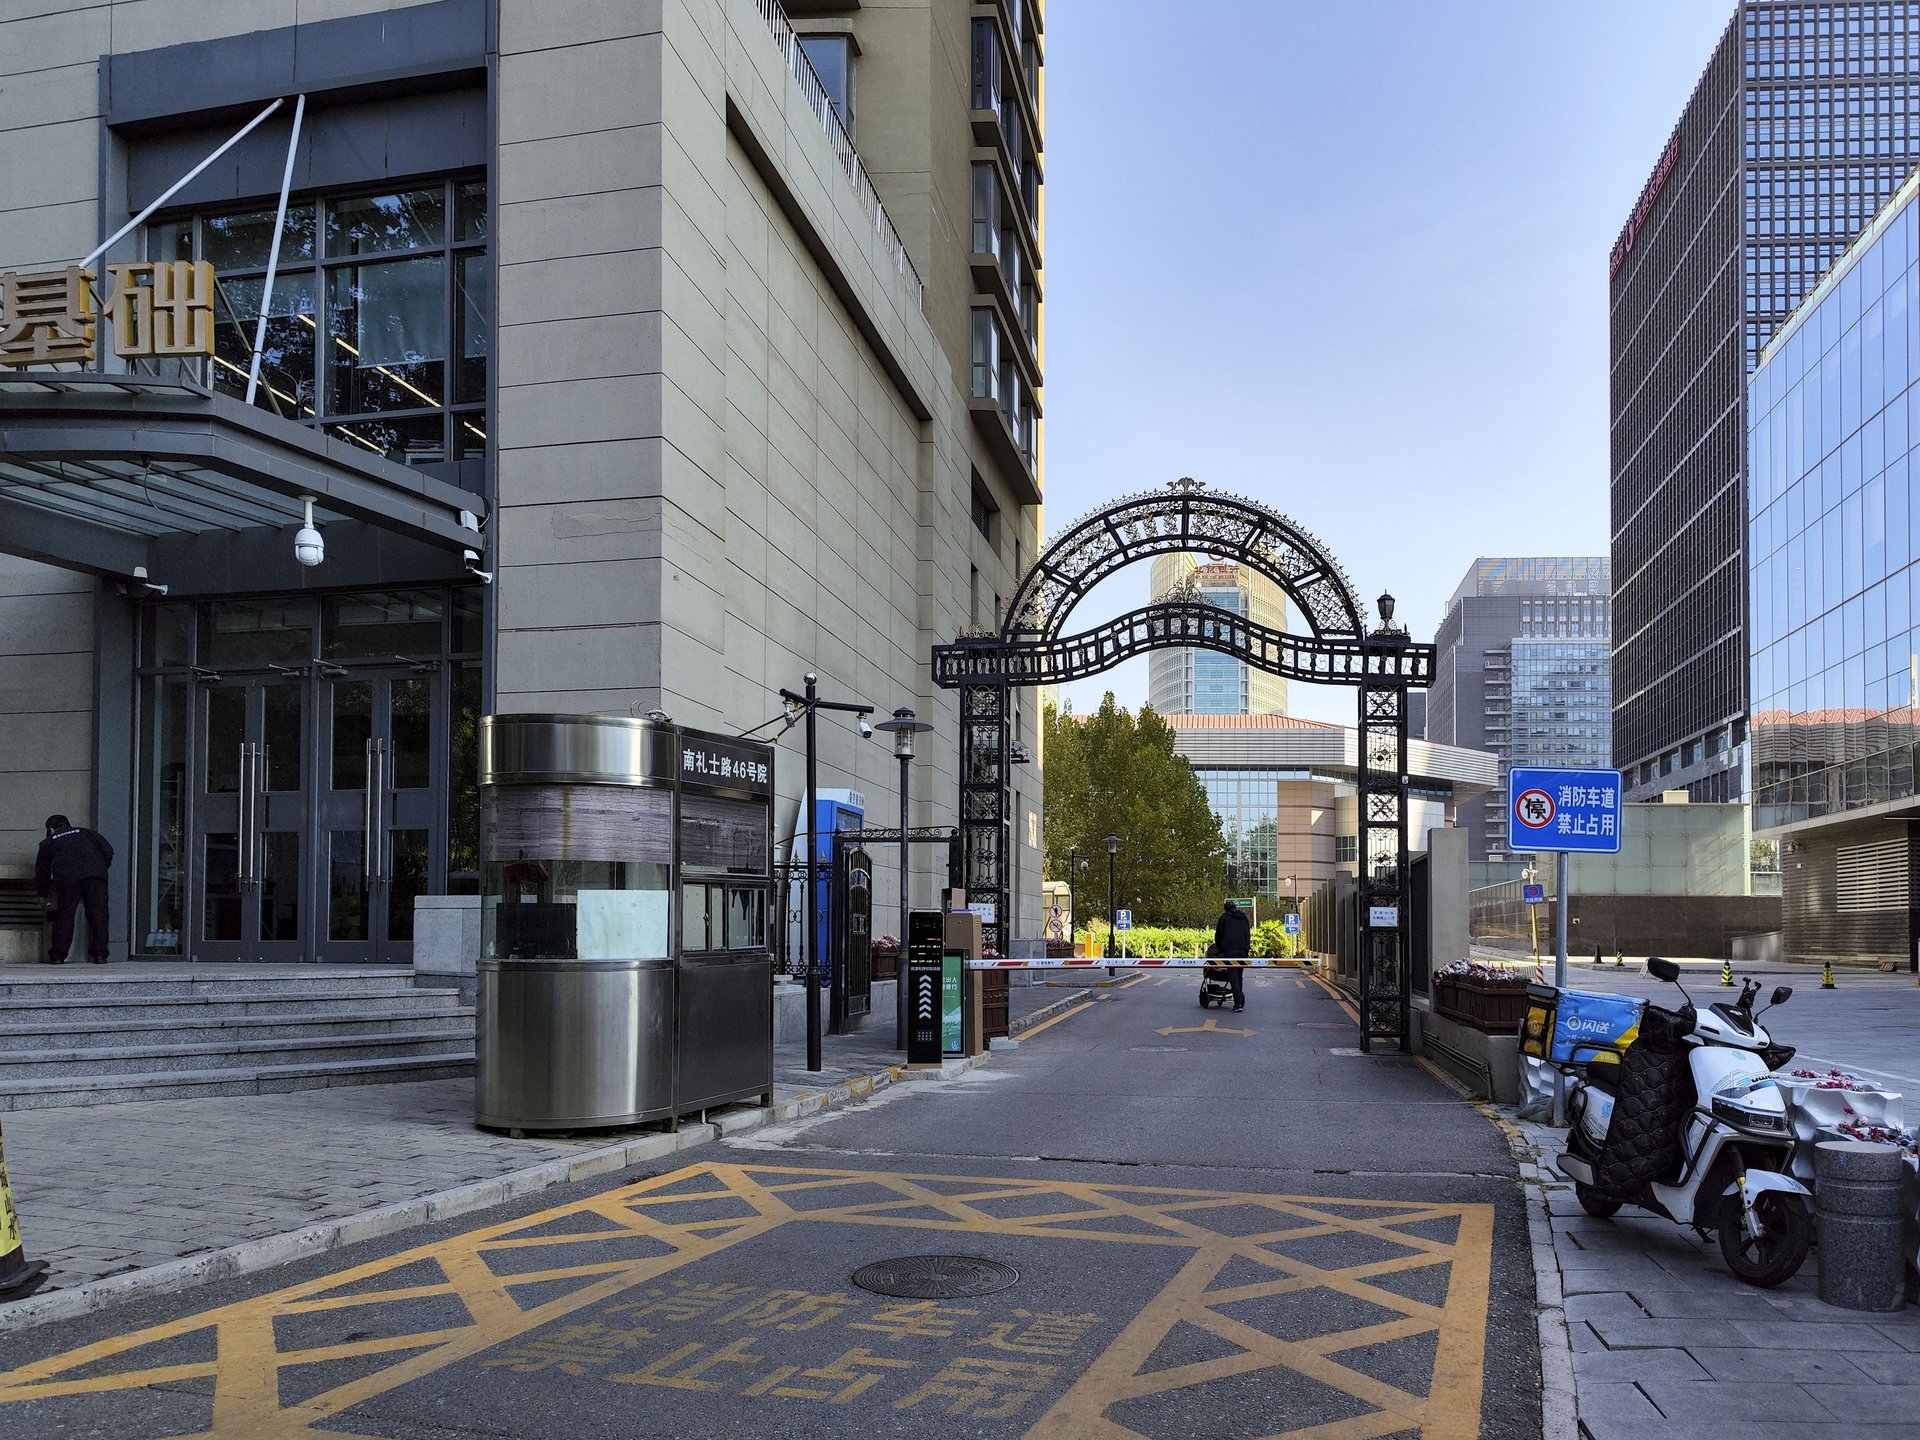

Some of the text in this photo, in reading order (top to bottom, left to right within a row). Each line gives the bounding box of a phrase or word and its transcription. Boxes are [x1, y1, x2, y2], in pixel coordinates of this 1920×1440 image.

[0, 260, 214, 367] 基础
[683, 748, 768, 784] 南礼士路46号院
[1525, 798, 1546, 819] 停
[1558, 785, 1615, 809] 消防车道
[1557, 812, 1615, 837] 禁止占用
[1581, 1018, 1611, 1035] 闪送
[602, 1279, 1107, 1357] 消防车道
[480, 1321, 1065, 1420] 禁止占用
